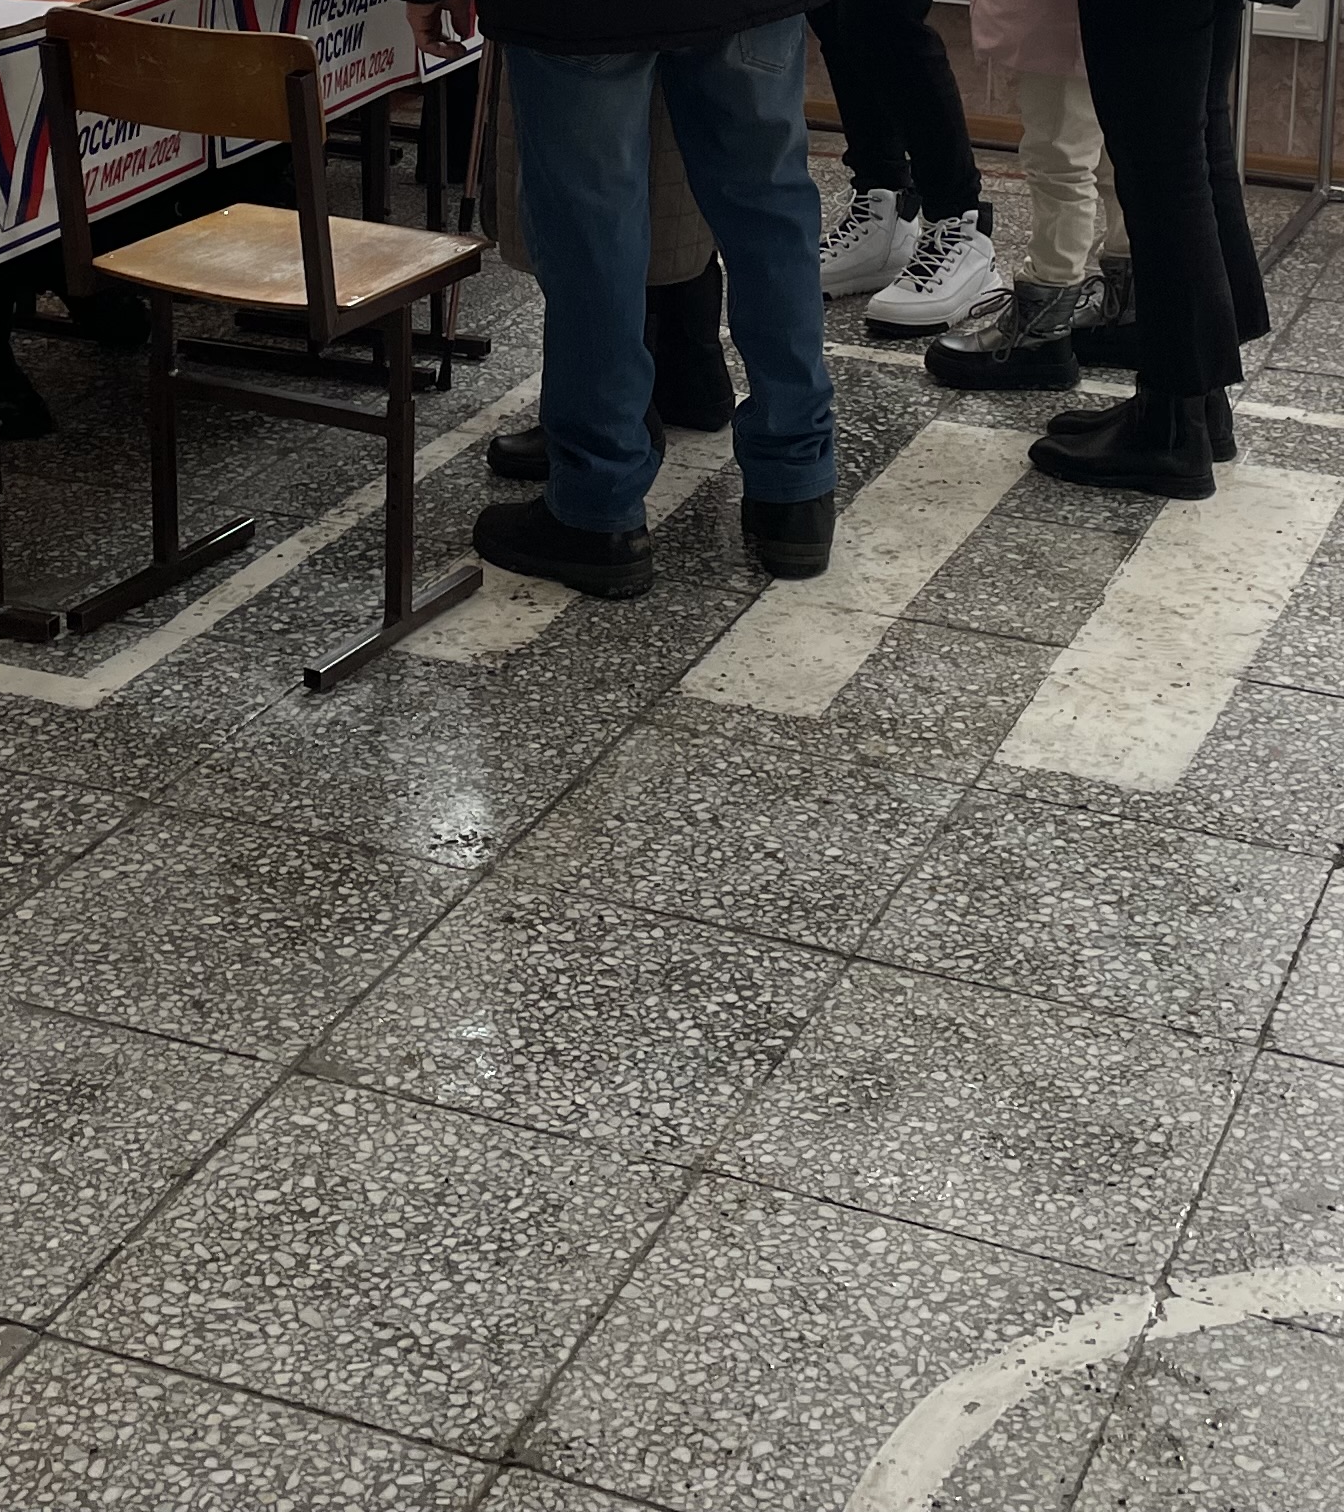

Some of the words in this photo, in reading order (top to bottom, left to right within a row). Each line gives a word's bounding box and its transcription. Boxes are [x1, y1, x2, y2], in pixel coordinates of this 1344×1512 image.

[315, 21, 365, 65] ОССИИ
[334, 57, 366, 94] МАРТА
[367, 47, 395, 79] 2024
[79, 118, 141, 159] ОССИИ
[100, 145, 148, 188] МАРТА
[148, 131, 181, 170] 2024
